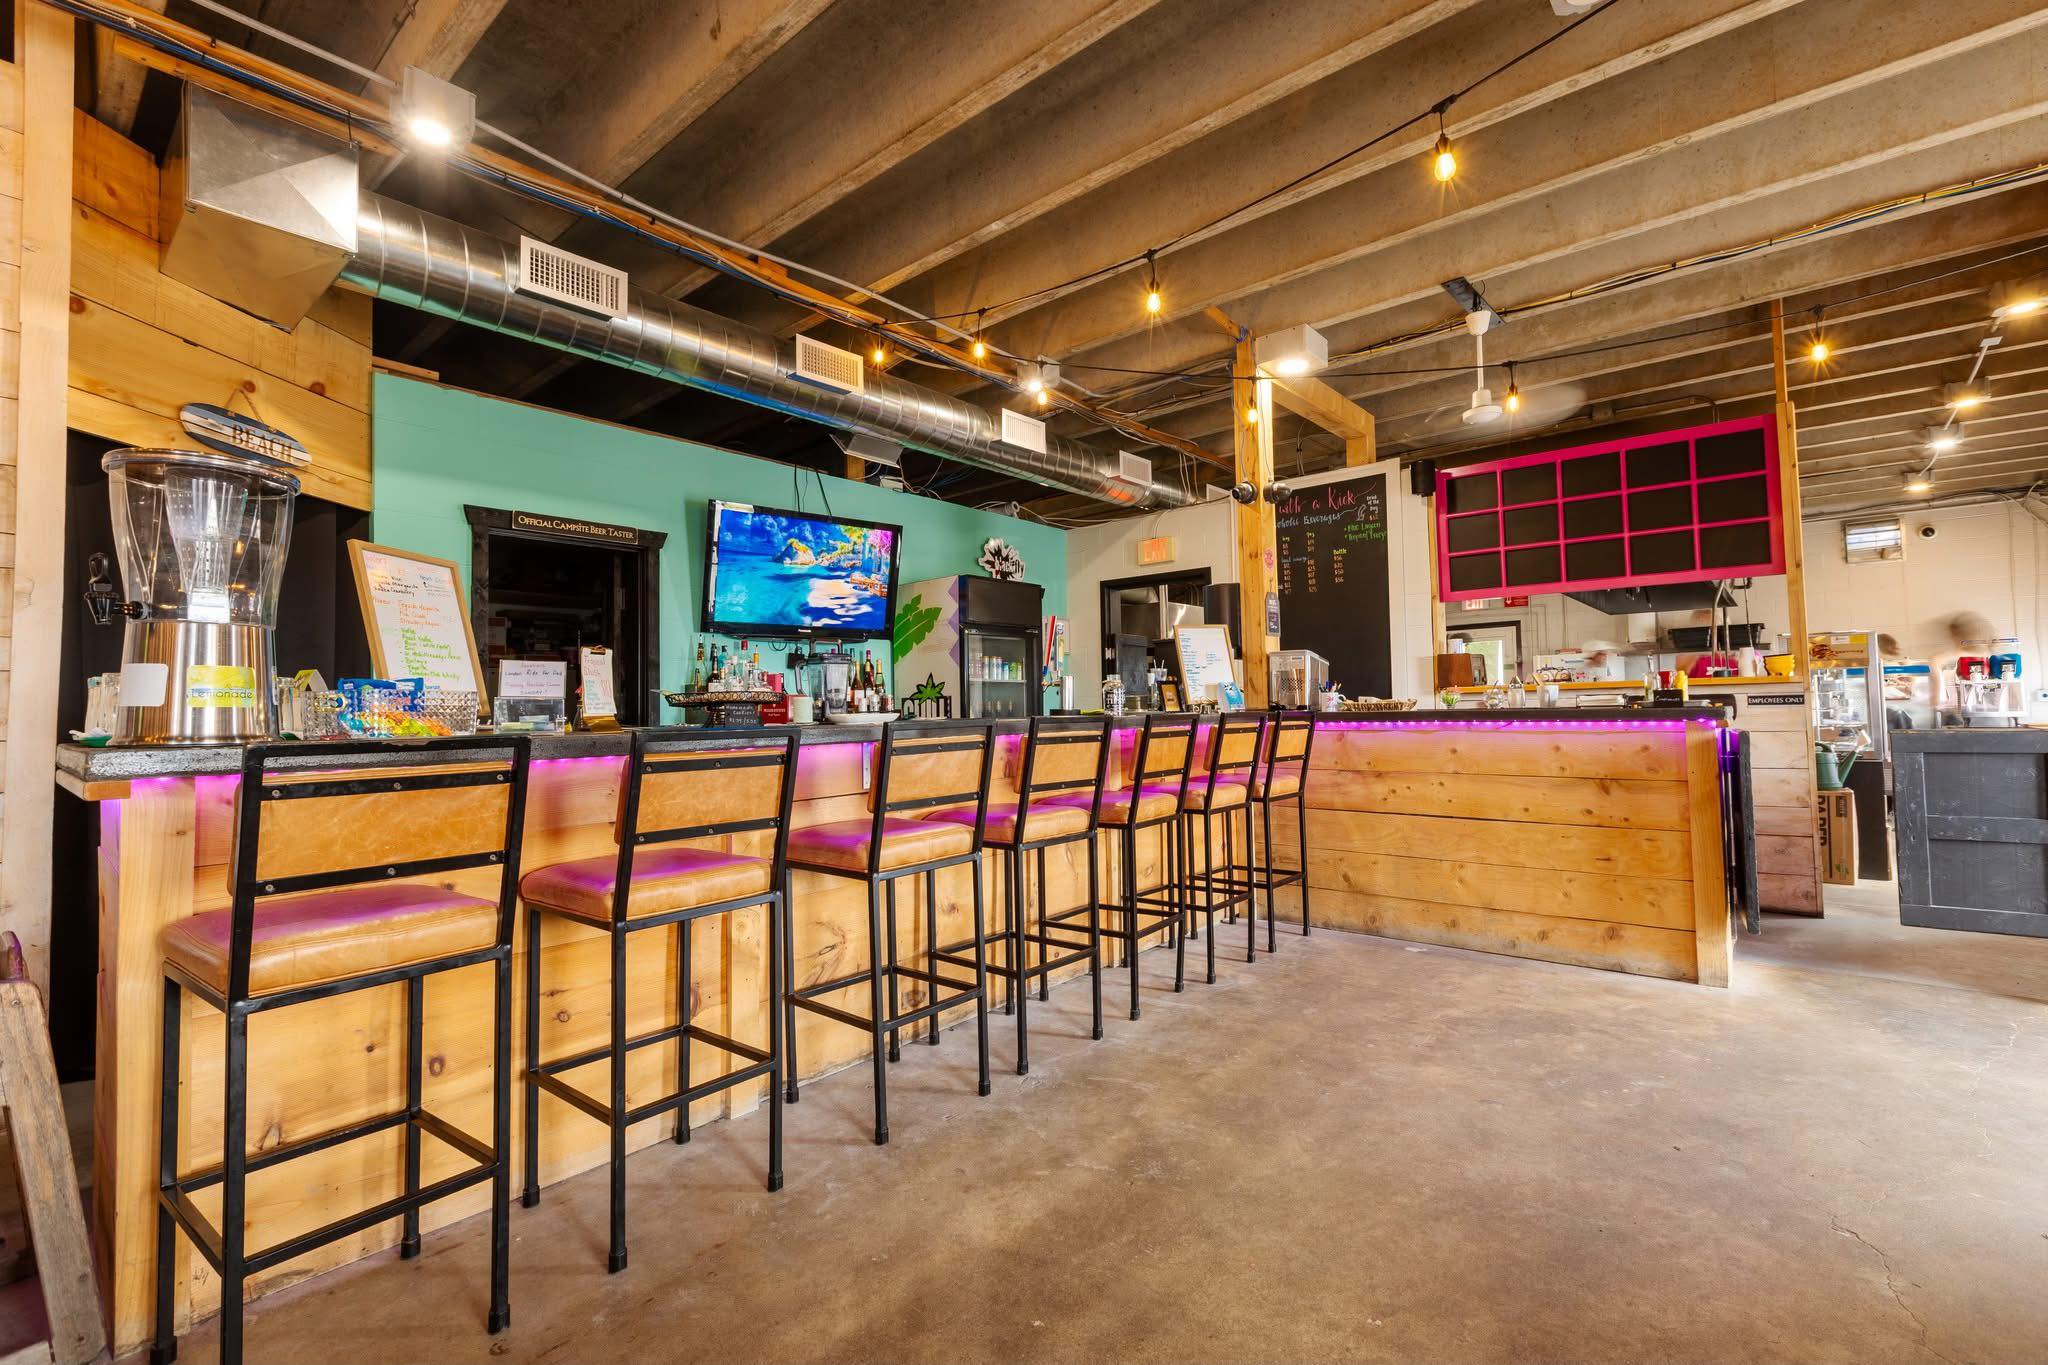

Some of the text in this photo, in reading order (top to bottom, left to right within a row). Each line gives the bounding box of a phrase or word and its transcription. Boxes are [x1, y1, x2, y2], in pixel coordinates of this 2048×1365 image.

[231, 424, 292, 463] BEACH
[1312, 500, 1320, 509] a
[1303, 512, 1341, 526] Beverages
[518, 515, 552, 528] OFFICIAL
[590, 525, 607, 536] BEER
[607, 528, 634, 539] TASTER
[191, 687, 253, 699] Lemonade
